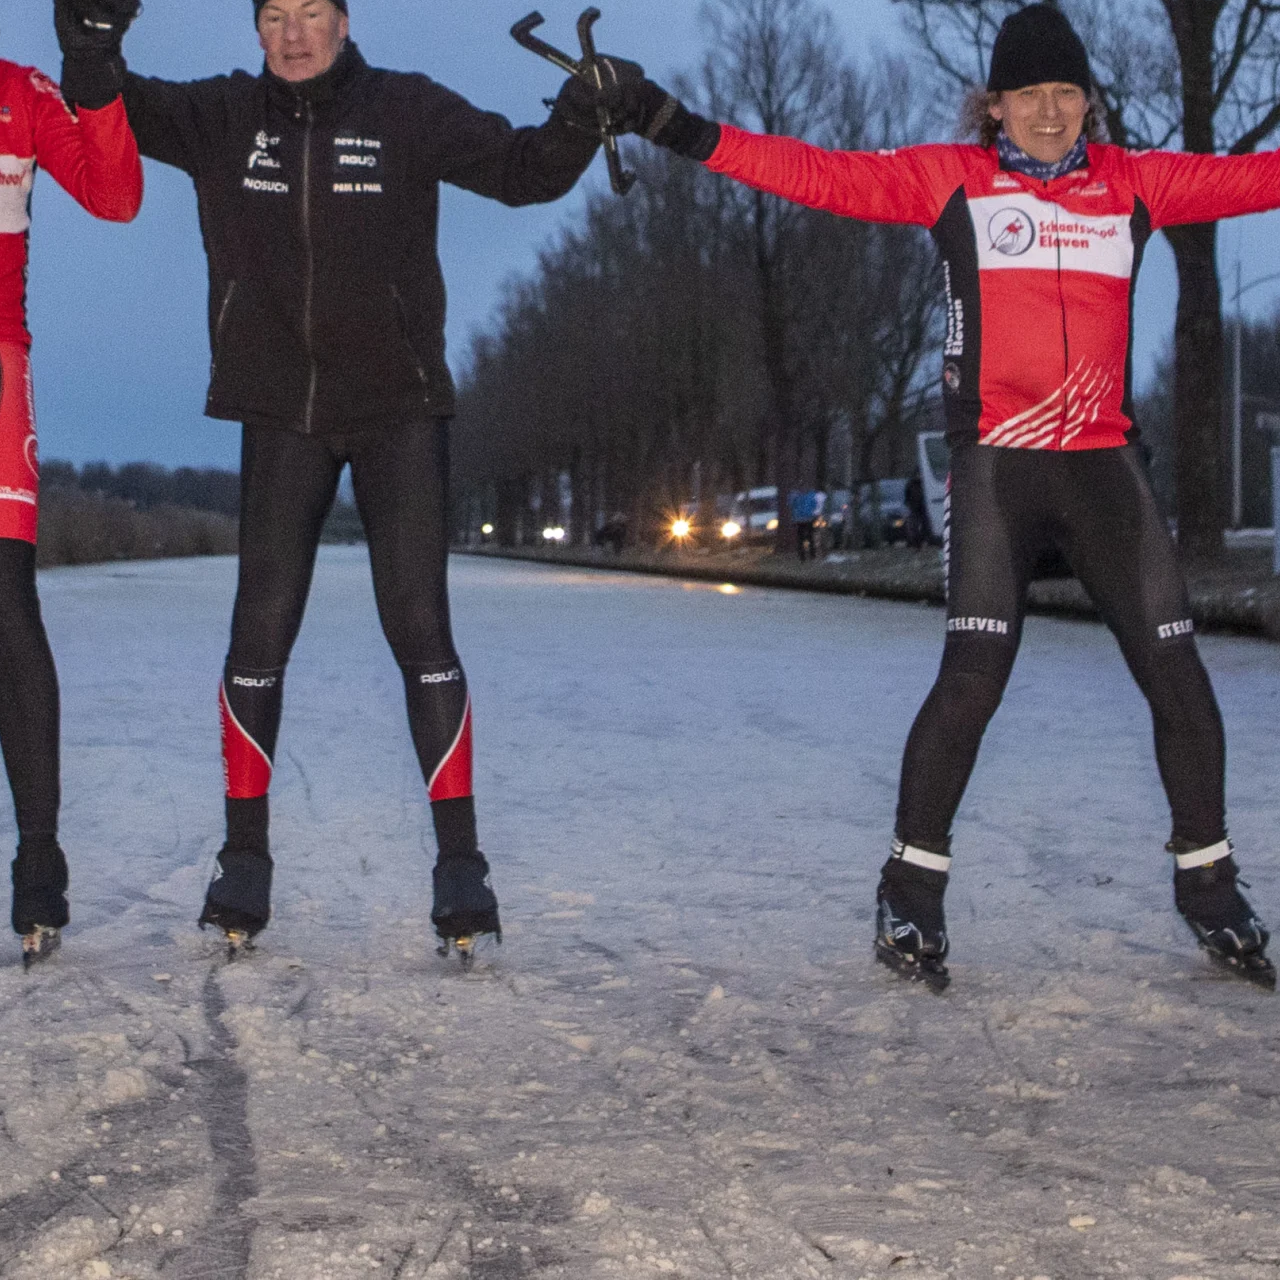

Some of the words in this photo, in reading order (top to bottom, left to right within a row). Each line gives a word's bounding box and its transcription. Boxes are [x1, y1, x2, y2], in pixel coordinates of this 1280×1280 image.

[244, 177, 289, 193] NOSUCH
[1039, 235, 1089, 249] Eleven
[952, 299, 964, 356] Eleven
[233, 676, 265, 687] AGU
[420, 671, 452, 684] AGU
